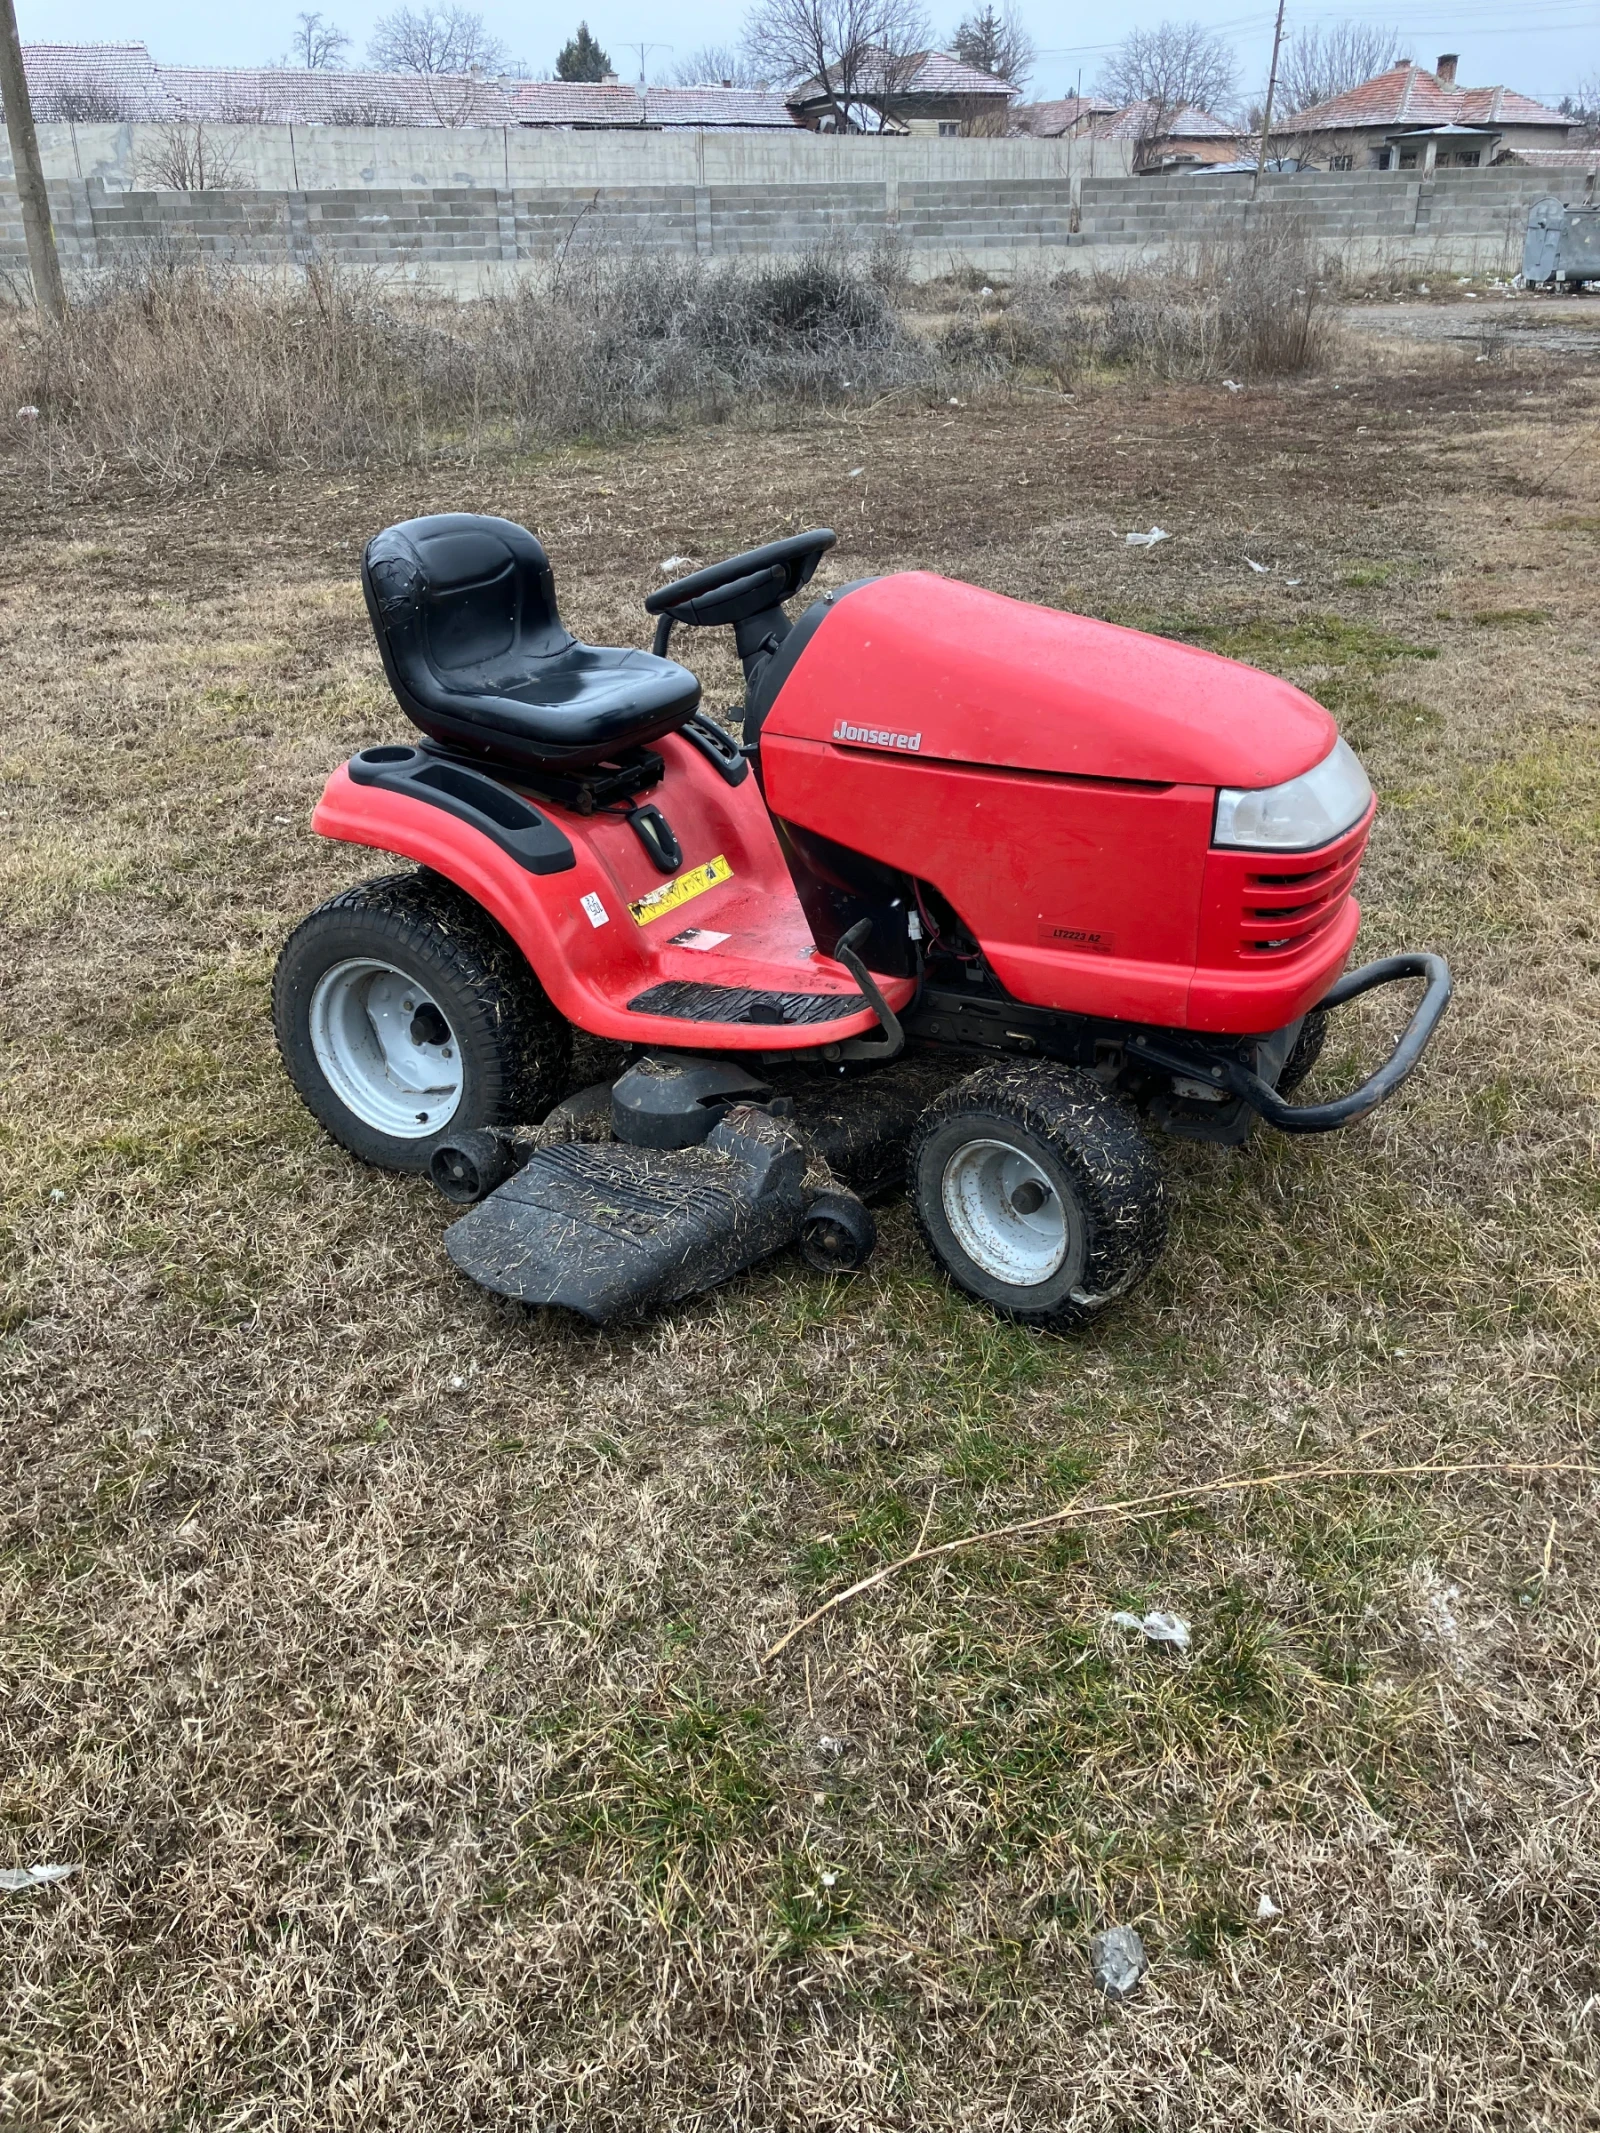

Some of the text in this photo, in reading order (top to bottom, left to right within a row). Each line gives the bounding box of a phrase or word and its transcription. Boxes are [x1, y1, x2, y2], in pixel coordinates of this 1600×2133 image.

[833, 721, 922, 751] Jonsered
[1053, 929, 1102, 943] LT2223 A2
